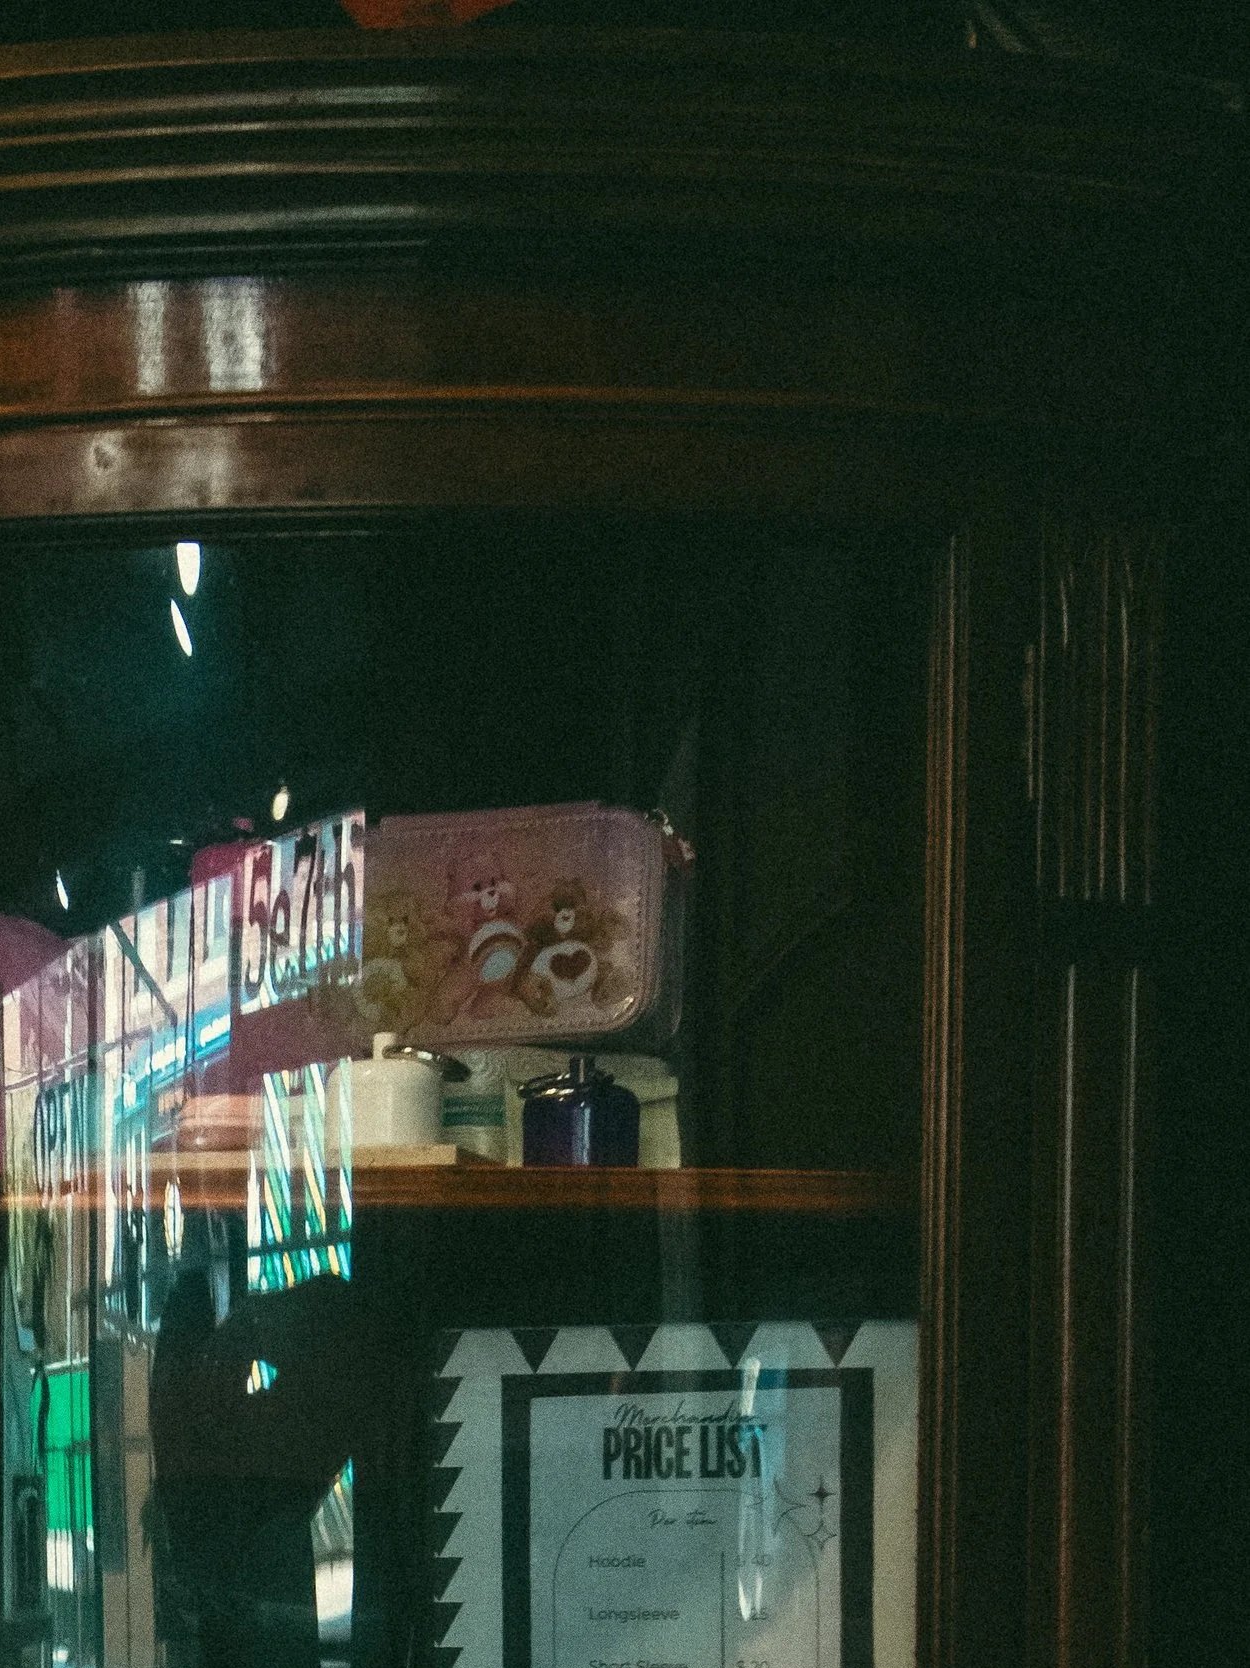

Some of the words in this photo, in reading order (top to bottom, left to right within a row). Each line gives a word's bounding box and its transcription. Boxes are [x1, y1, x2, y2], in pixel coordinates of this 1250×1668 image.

[603, 1425, 692, 1480] PRICE
[699, 1424, 768, 1479] LIST
[588, 1555, 647, 1568] Hoodie
[588, 1607, 680, 1623] Longsleeve
